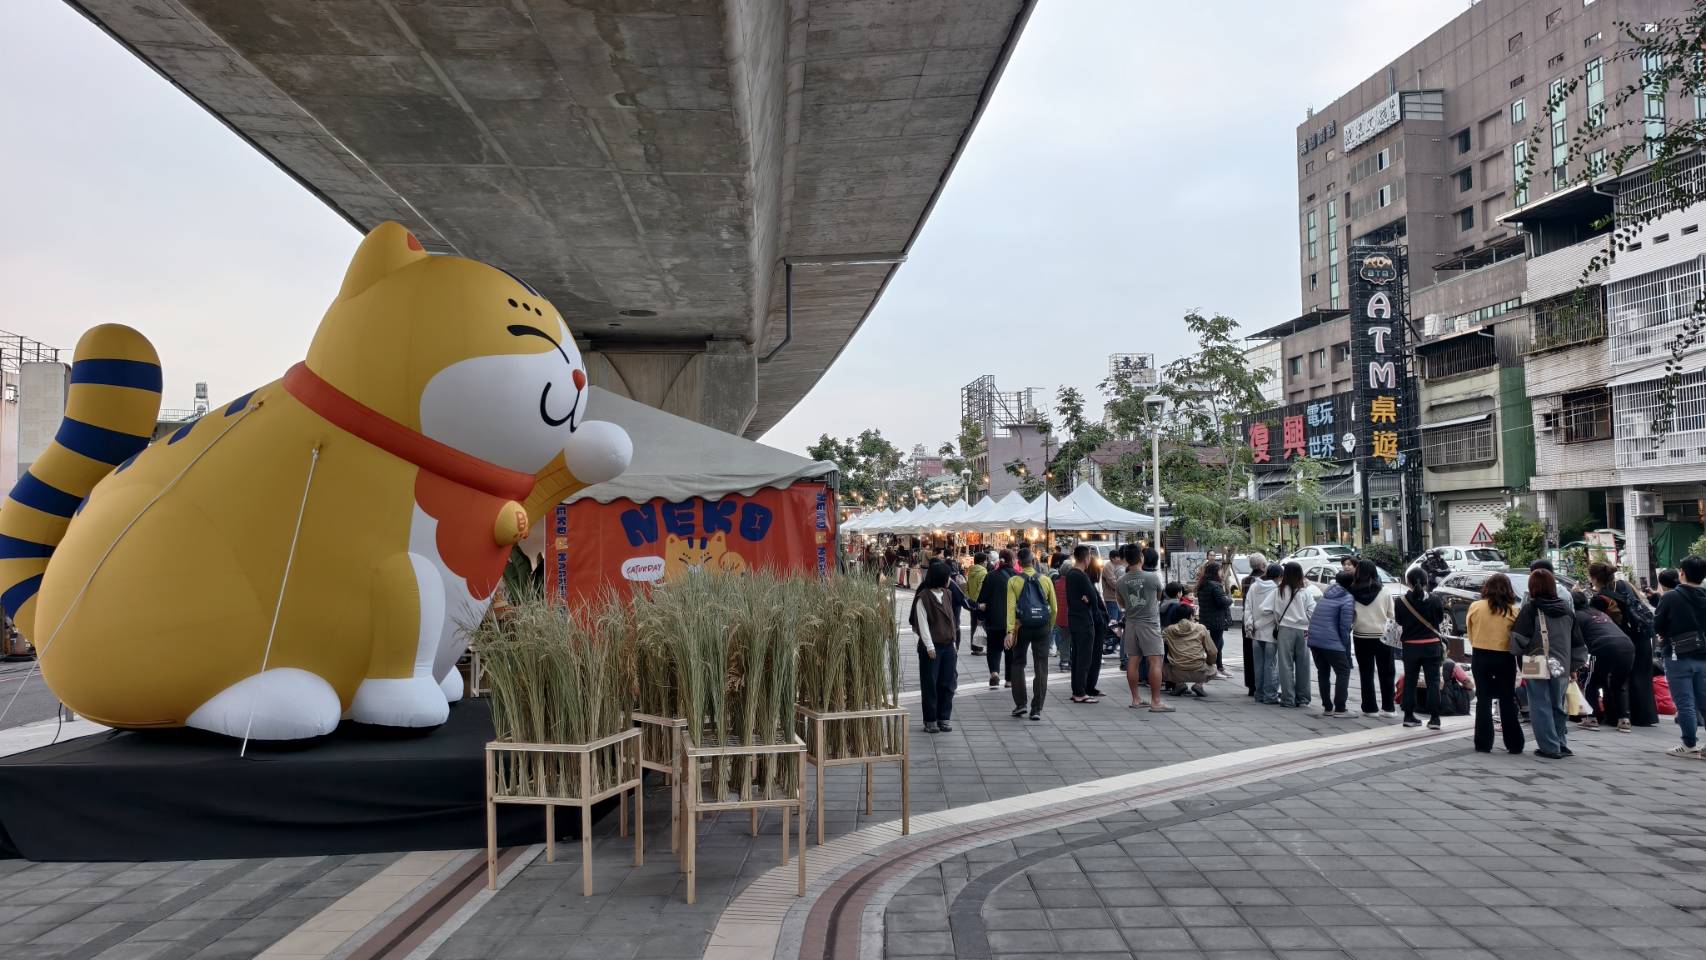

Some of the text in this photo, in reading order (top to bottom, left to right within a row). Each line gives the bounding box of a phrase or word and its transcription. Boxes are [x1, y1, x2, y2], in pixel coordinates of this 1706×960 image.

[1367, 291, 1396, 389] ATM
[1306, 401, 1334, 427] 電玩
[1371, 396, 1398, 458] 桌遊
[1308, 432, 1336, 459] 世界
[620, 498, 773, 547] NEKO
